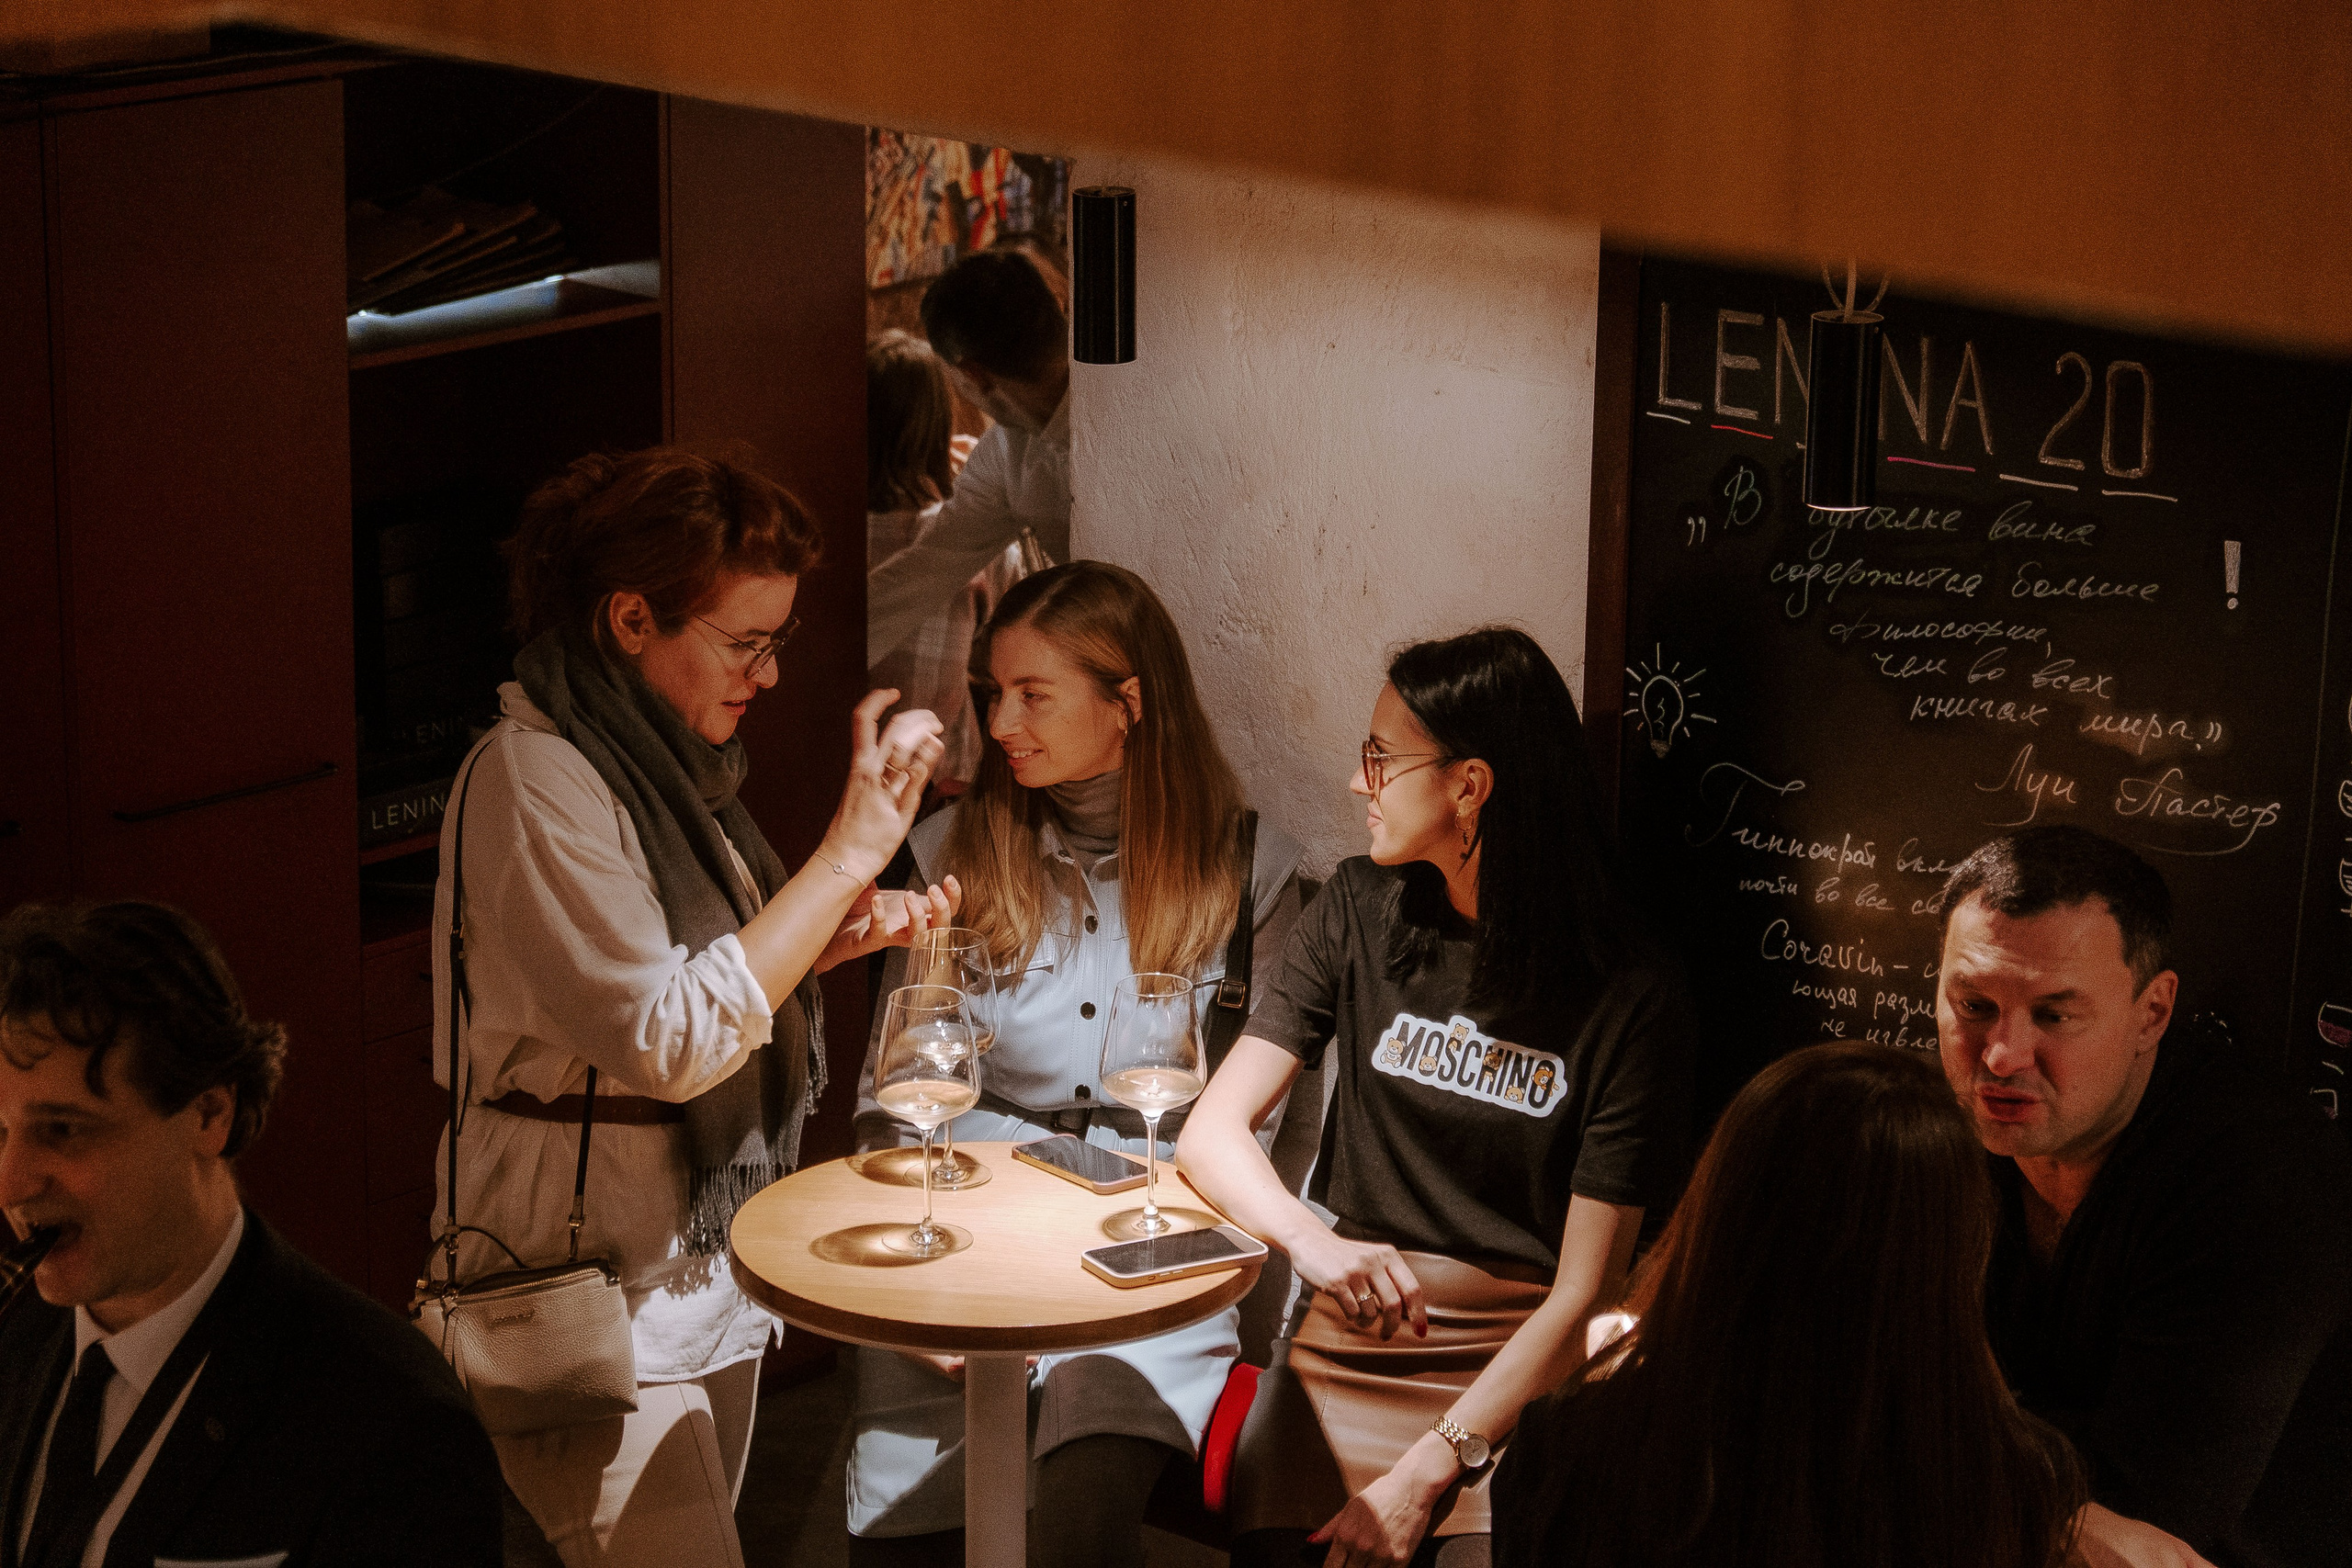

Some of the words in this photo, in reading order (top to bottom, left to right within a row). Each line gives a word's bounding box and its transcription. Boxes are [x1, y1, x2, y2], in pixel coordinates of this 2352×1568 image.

[1658, 302, 1993, 455] LENNA
[2039, 351, 2154, 479] 20
[1987, 501, 2098, 547] вина
[1770, 558, 1984, 618] содержится
[2011, 561, 2160, 603] больше
[1871, 651, 1947, 678] чем
[1967, 647, 2008, 684] во
[2031, 659, 2113, 699] всех
[1910, 695, 2050, 726] книгах
[1975, 743, 2077, 827] Луи
[2115, 768, 2281, 855] Пастер
[1896, 838, 1961, 874] вкл
[1739, 875, 1798, 896] почти
[1815, 877, 1840, 903] во
[1855, 883, 1895, 910] все
[1820, 1019, 1846, 1038] не
[1391, 1021, 1556, 1110] MOSCHINO
